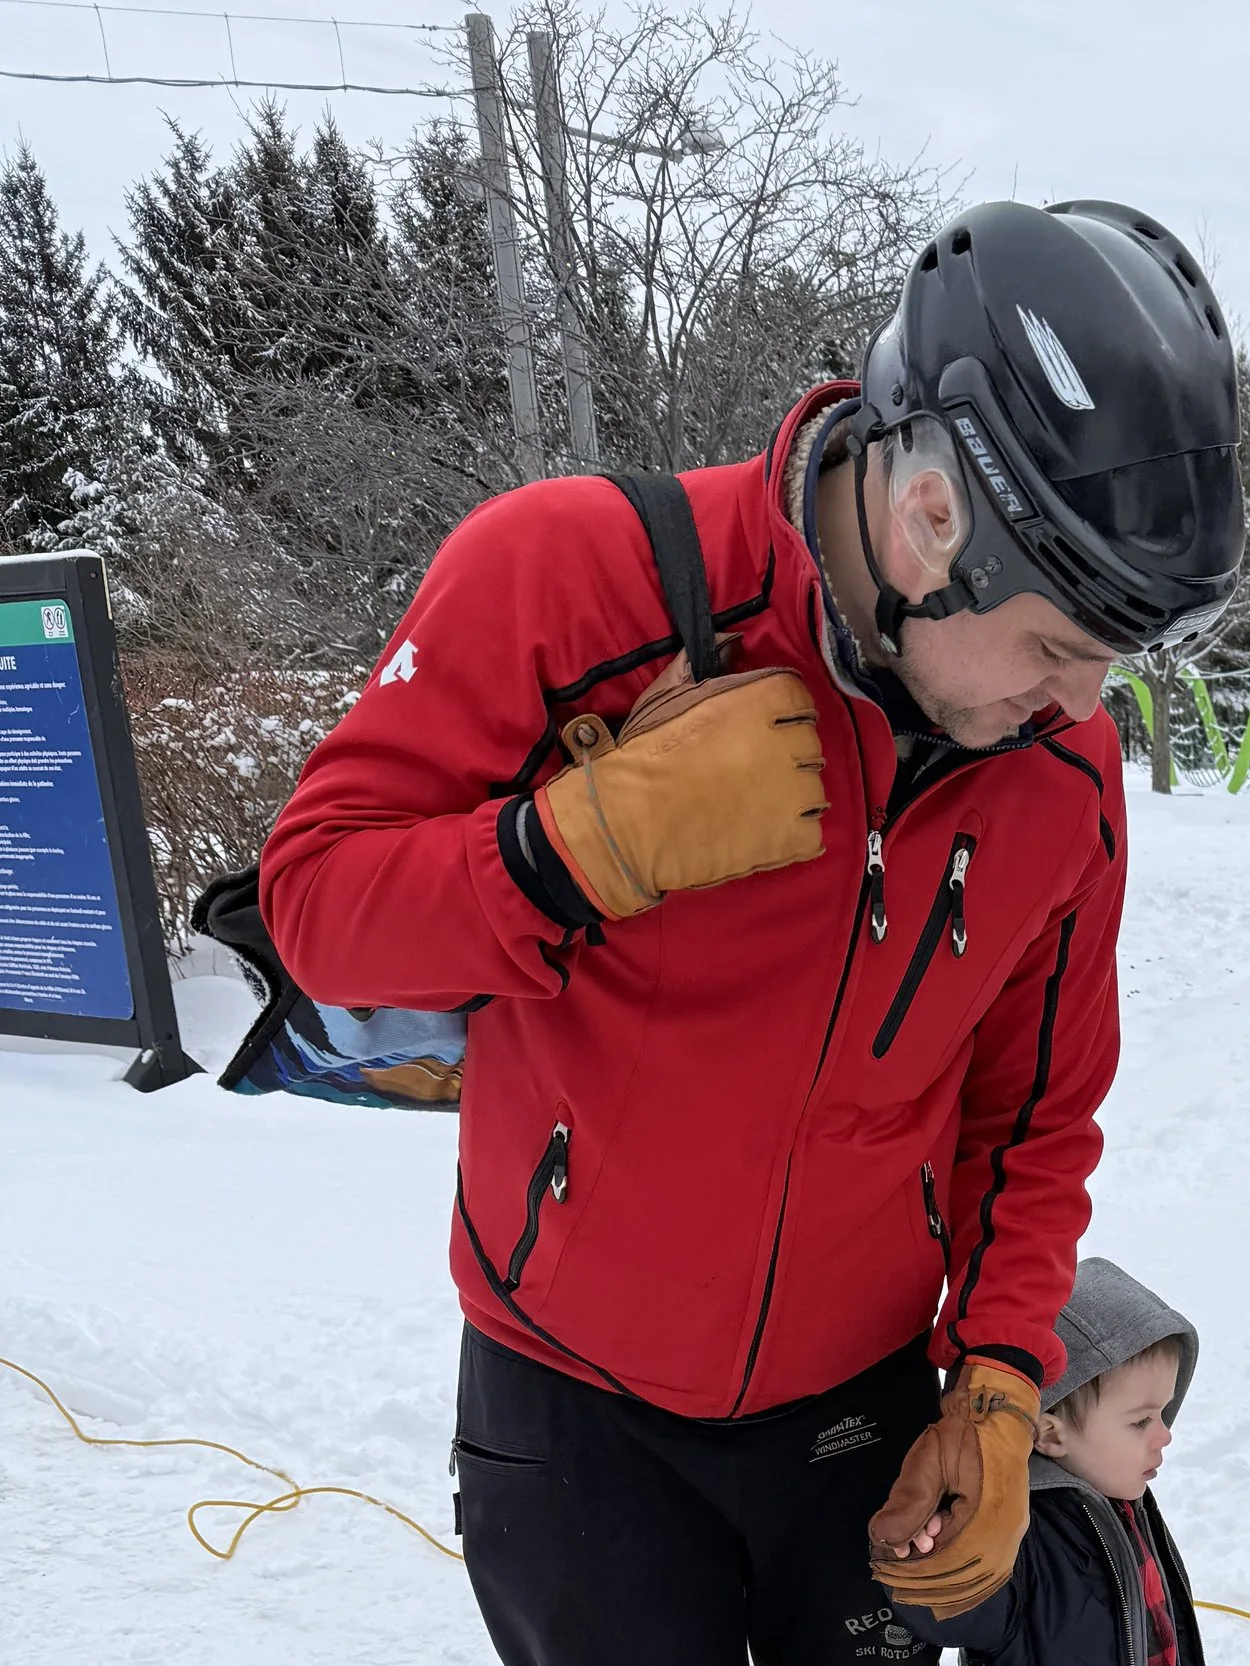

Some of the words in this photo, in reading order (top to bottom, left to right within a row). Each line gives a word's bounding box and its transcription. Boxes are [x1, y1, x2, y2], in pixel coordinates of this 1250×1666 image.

[955, 417, 1023, 513] BAUER
[814, 1431, 873, 1455] WINDMASTER
[856, 1646, 876, 1657] SKI
